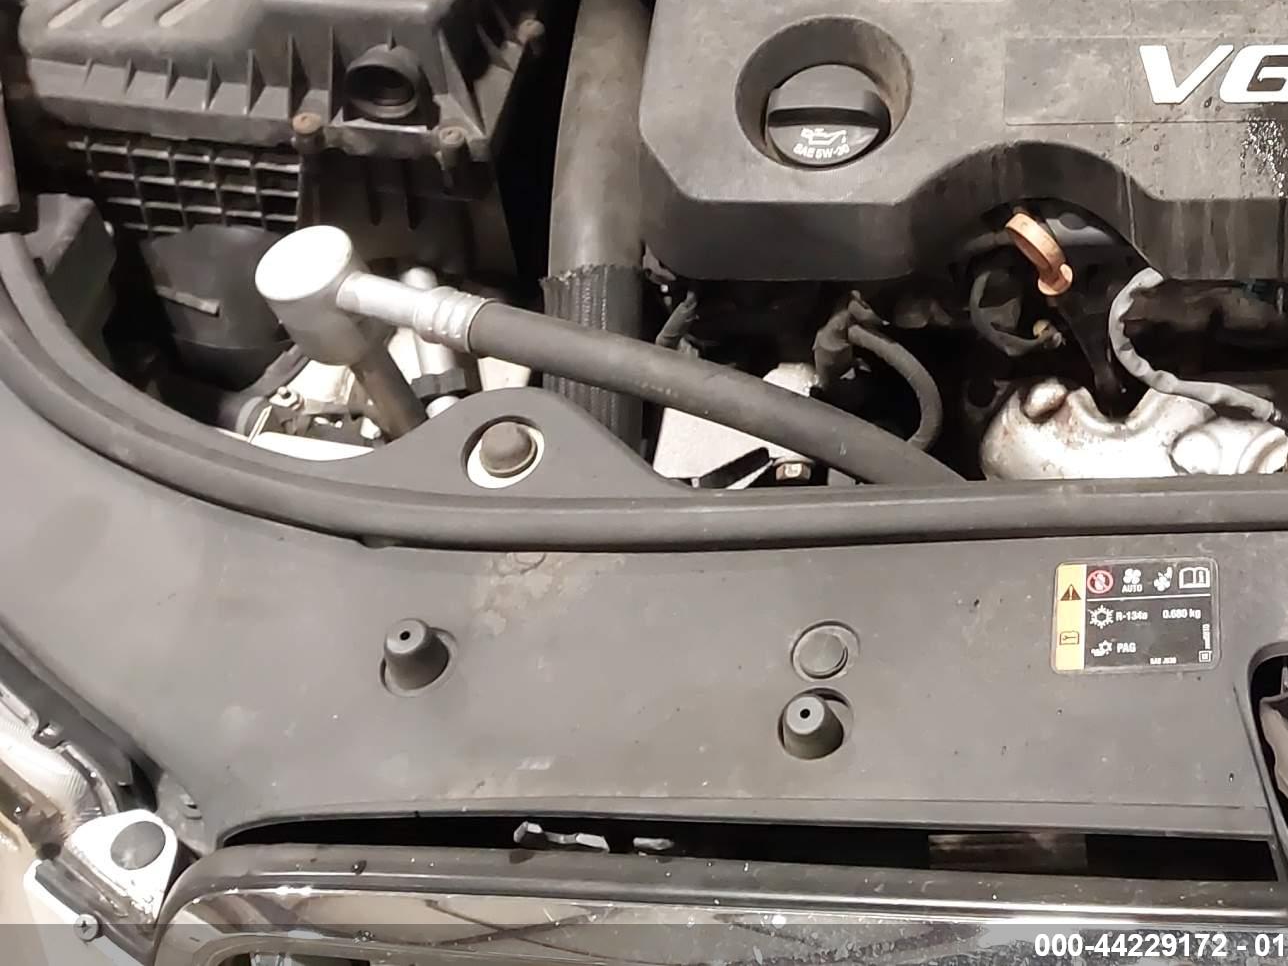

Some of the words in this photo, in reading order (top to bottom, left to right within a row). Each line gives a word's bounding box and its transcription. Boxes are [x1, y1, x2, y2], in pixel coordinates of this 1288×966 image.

[793, 143, 815, 158] SAE
[1122, 584, 1143, 593] AUTO
[1189, 608, 1201, 619] kg
[1116, 642, 1136, 653] PAG
